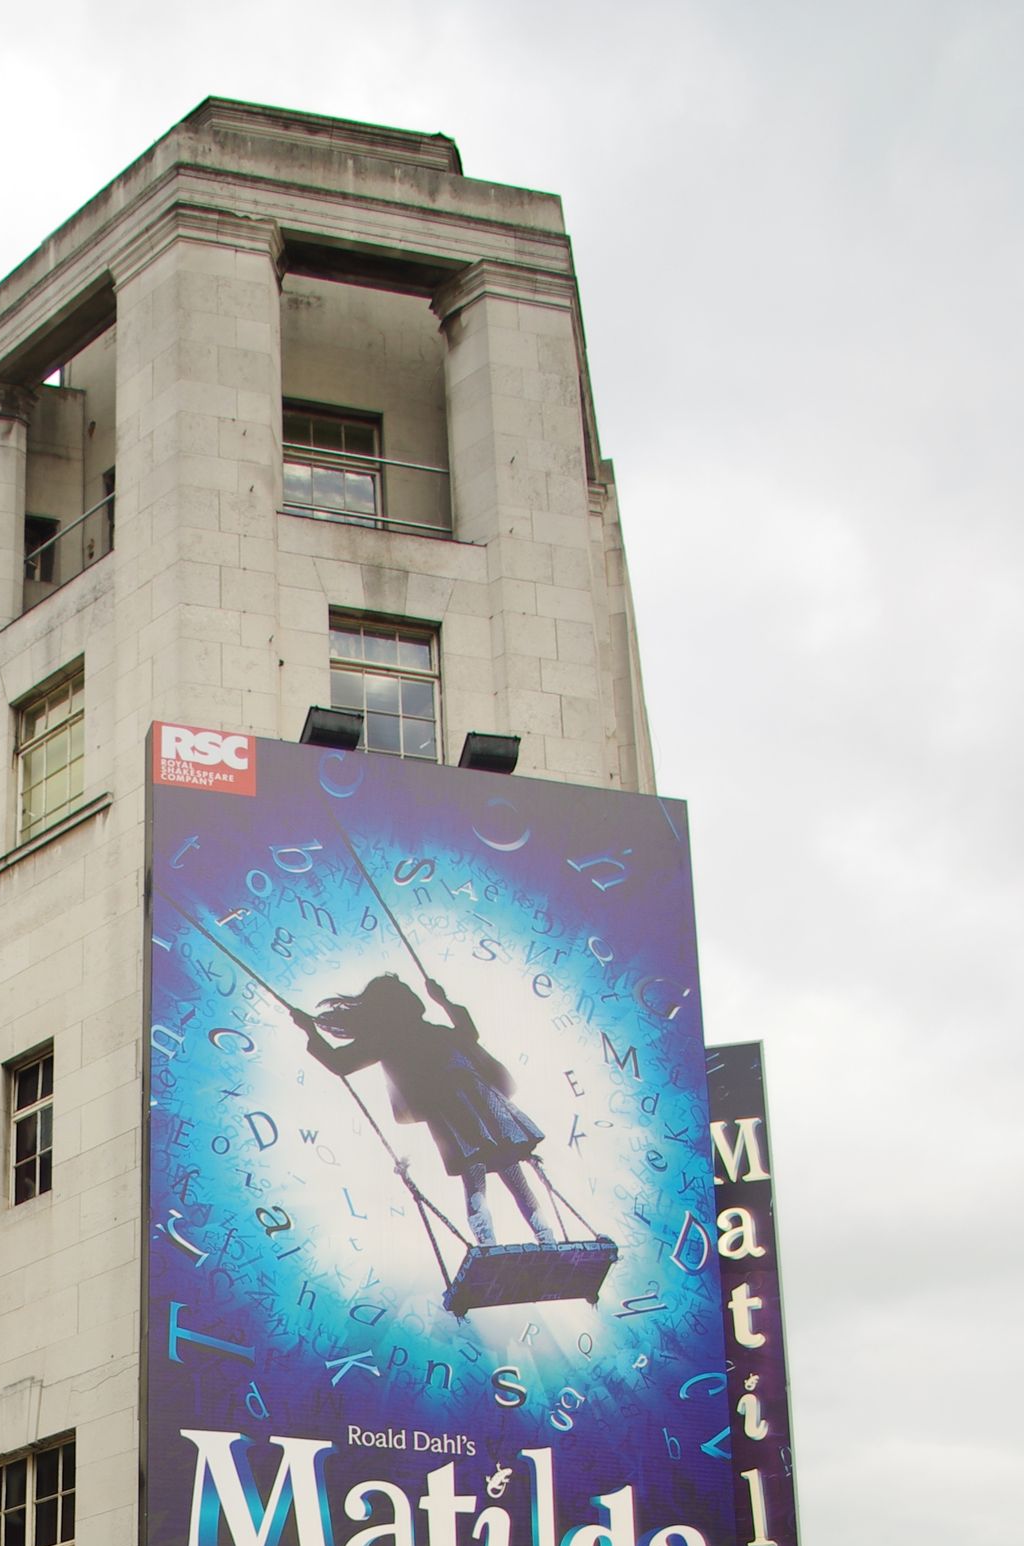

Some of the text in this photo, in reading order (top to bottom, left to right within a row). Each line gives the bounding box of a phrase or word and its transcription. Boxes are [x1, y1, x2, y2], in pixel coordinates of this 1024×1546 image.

[161, 725, 248, 770] RSC
[160, 758, 193, 769] ROYAL
[160, 765, 235, 782] SHAKESPEARE
[160, 773, 213, 785] COMPANY
[347, 1425, 476, 1456] Roald Dahl's
